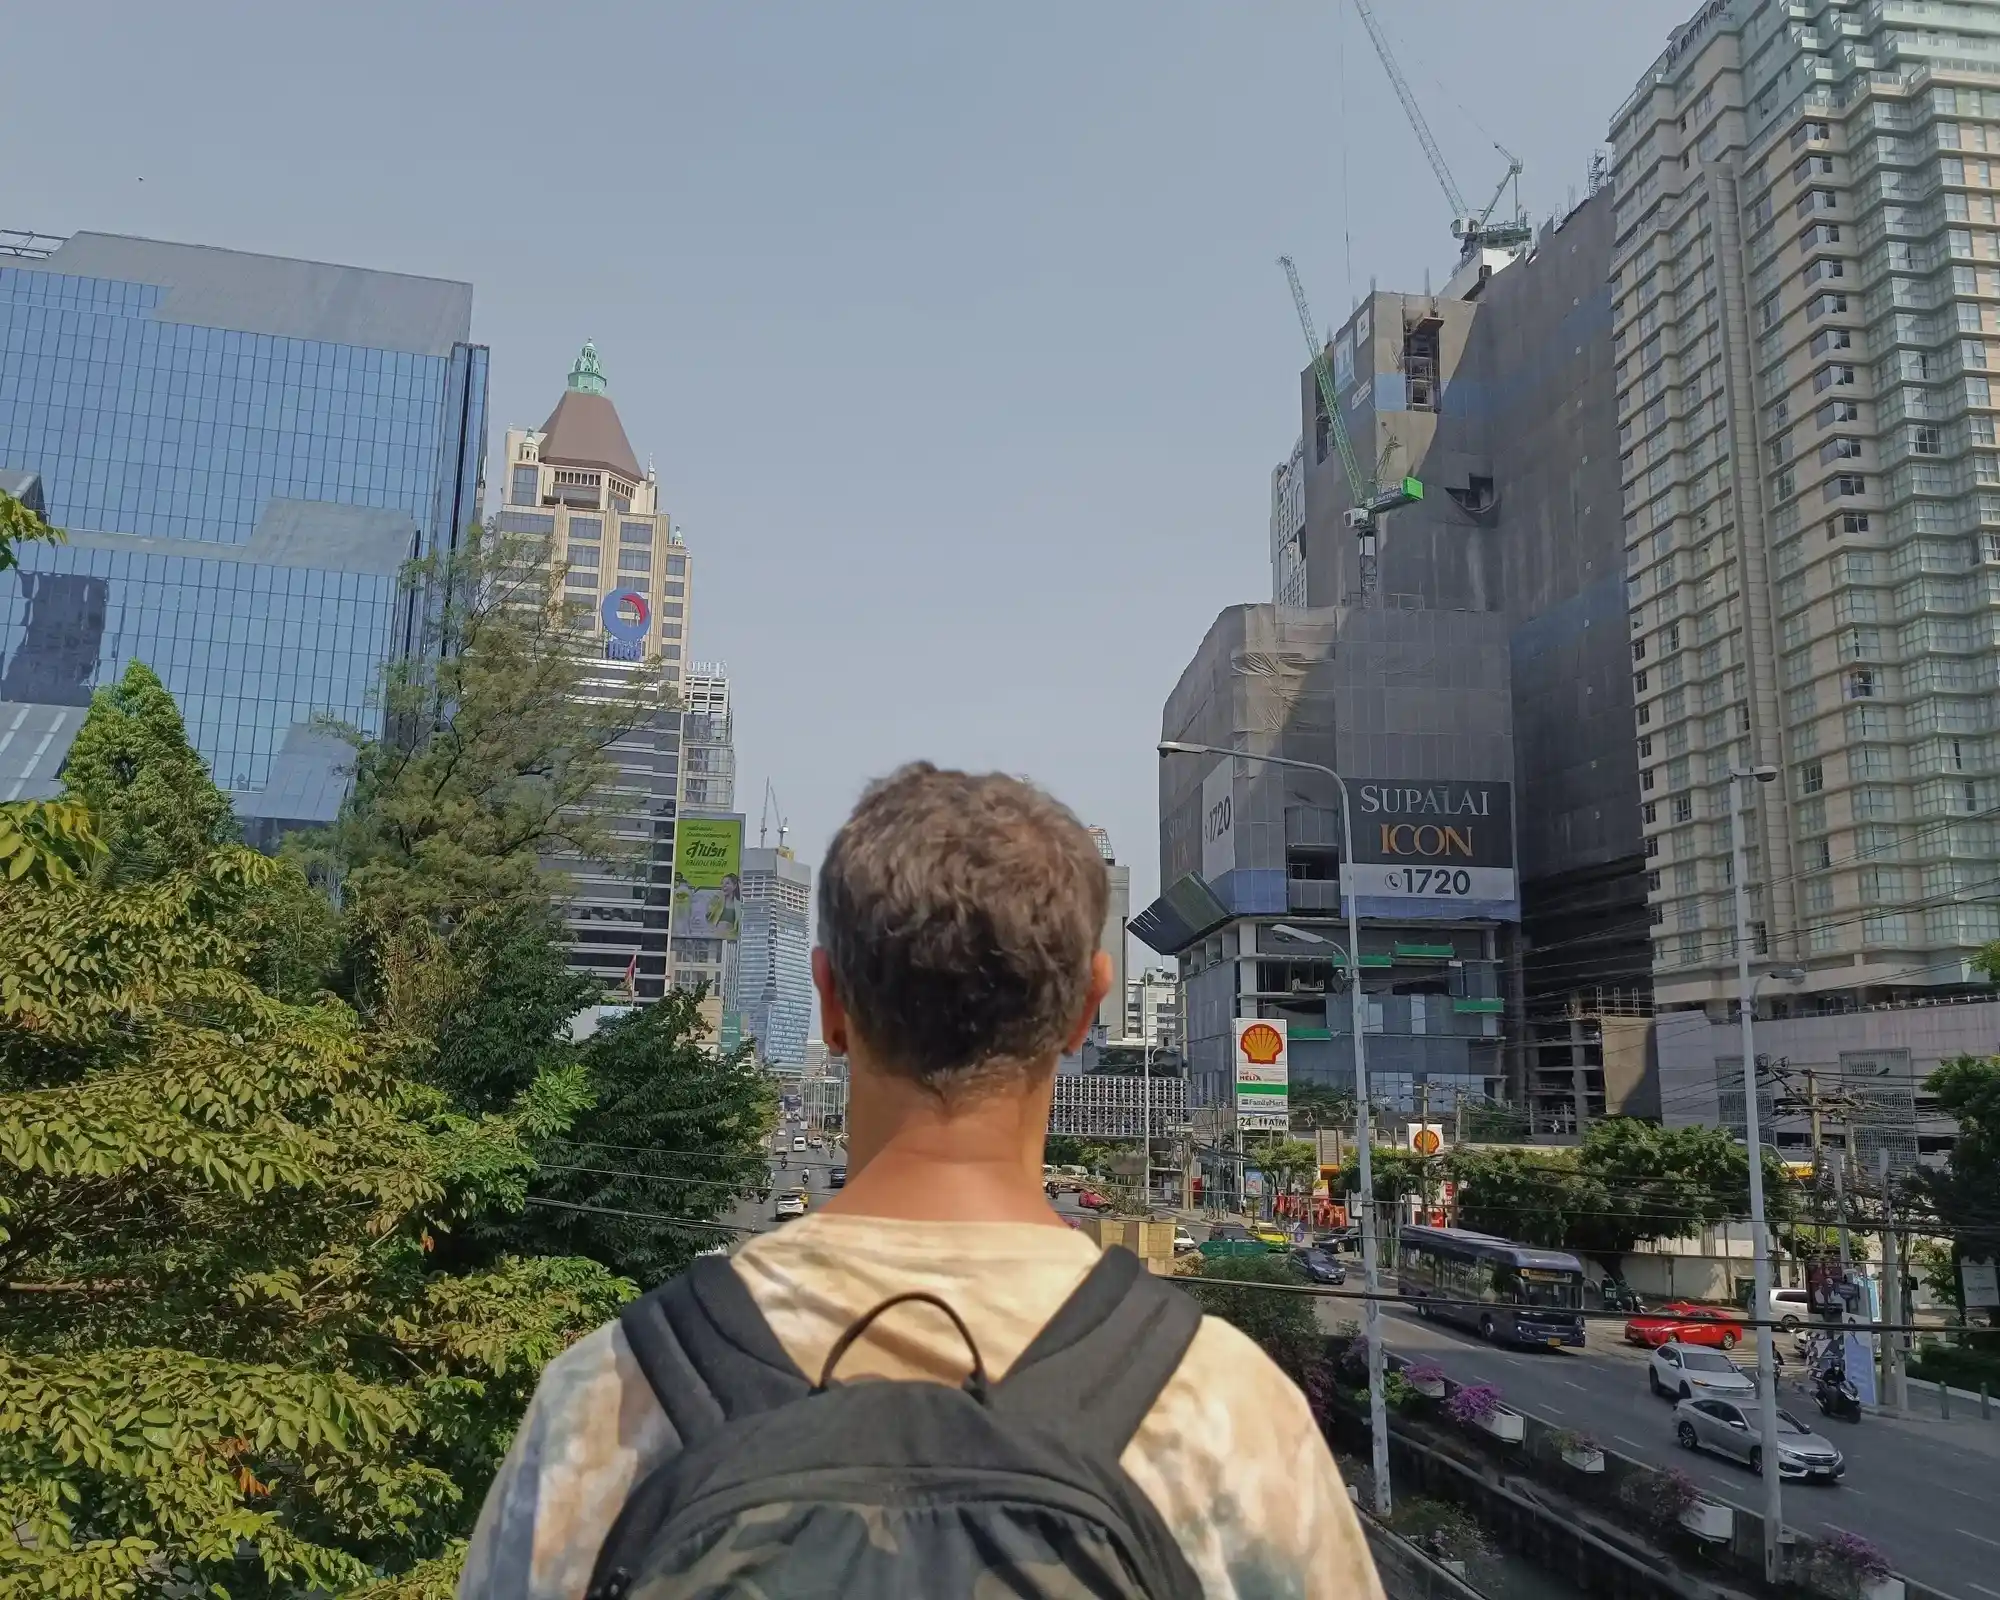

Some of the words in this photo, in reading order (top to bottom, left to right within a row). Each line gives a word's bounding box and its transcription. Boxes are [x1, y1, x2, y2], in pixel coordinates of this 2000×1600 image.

[1360, 784, 1490, 816] SUPALAI
[1209, 795, 1231, 843] 1720
[1380, 823, 1474, 857] ICON
[1402, 868, 1471, 895] 1720
[1240, 1117, 1251, 1126] 24
